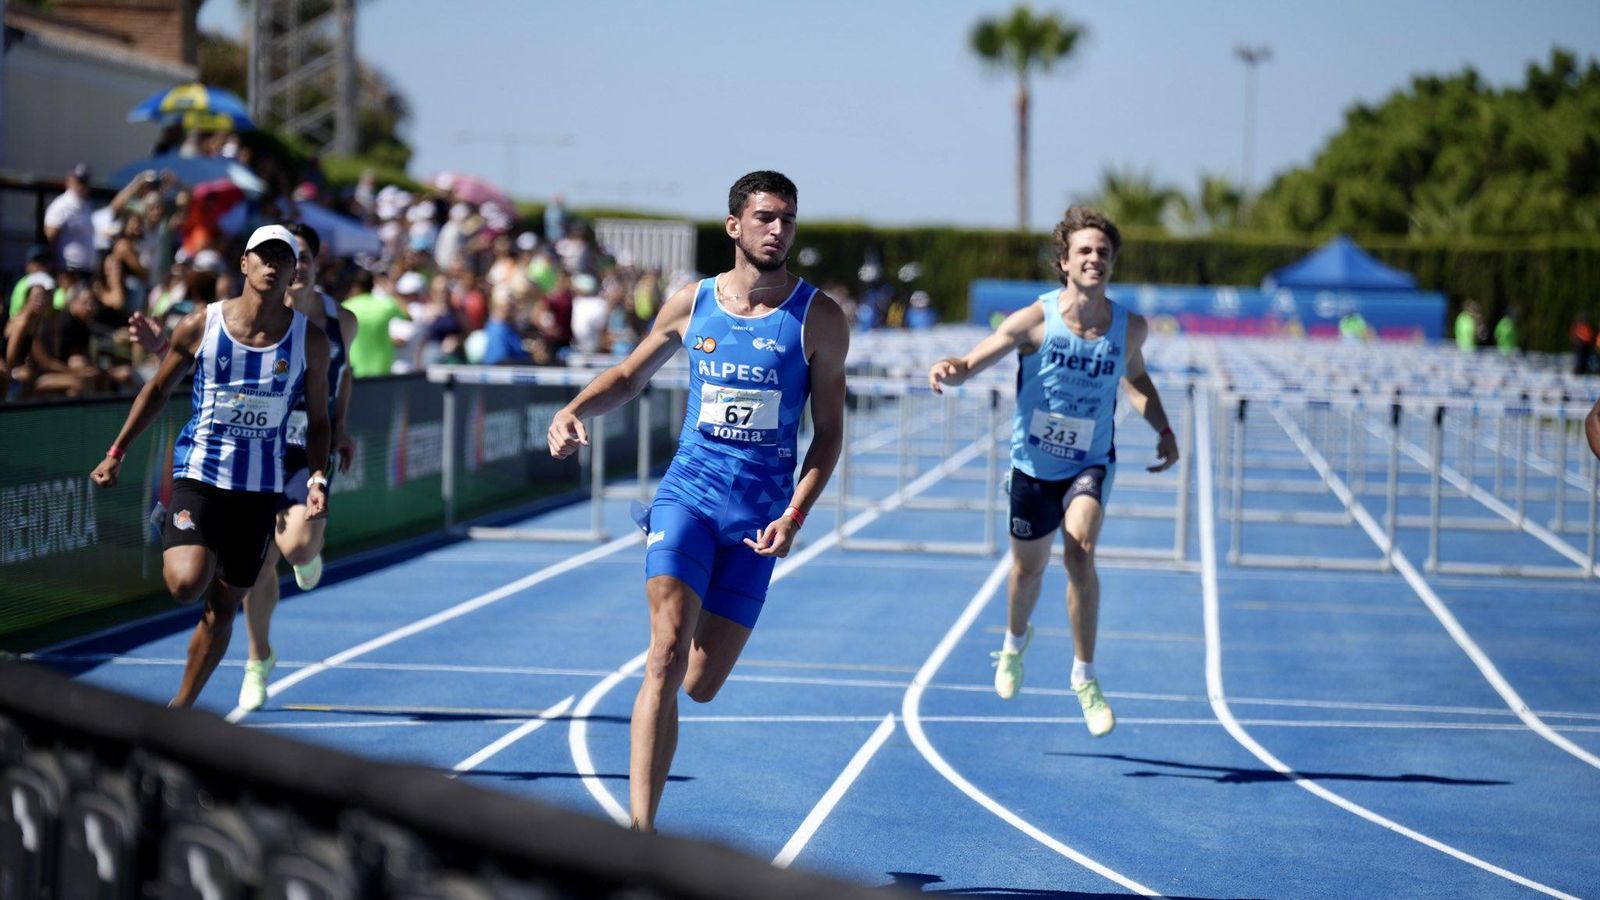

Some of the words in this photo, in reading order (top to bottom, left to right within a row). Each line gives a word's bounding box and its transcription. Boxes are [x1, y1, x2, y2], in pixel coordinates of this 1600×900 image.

[698, 359, 779, 385] ALPESA
[1050, 351, 1115, 378] nerja
[229, 409, 268, 427] 206
[724, 405, 754, 426] 67
[1043, 425, 1078, 446] 243
